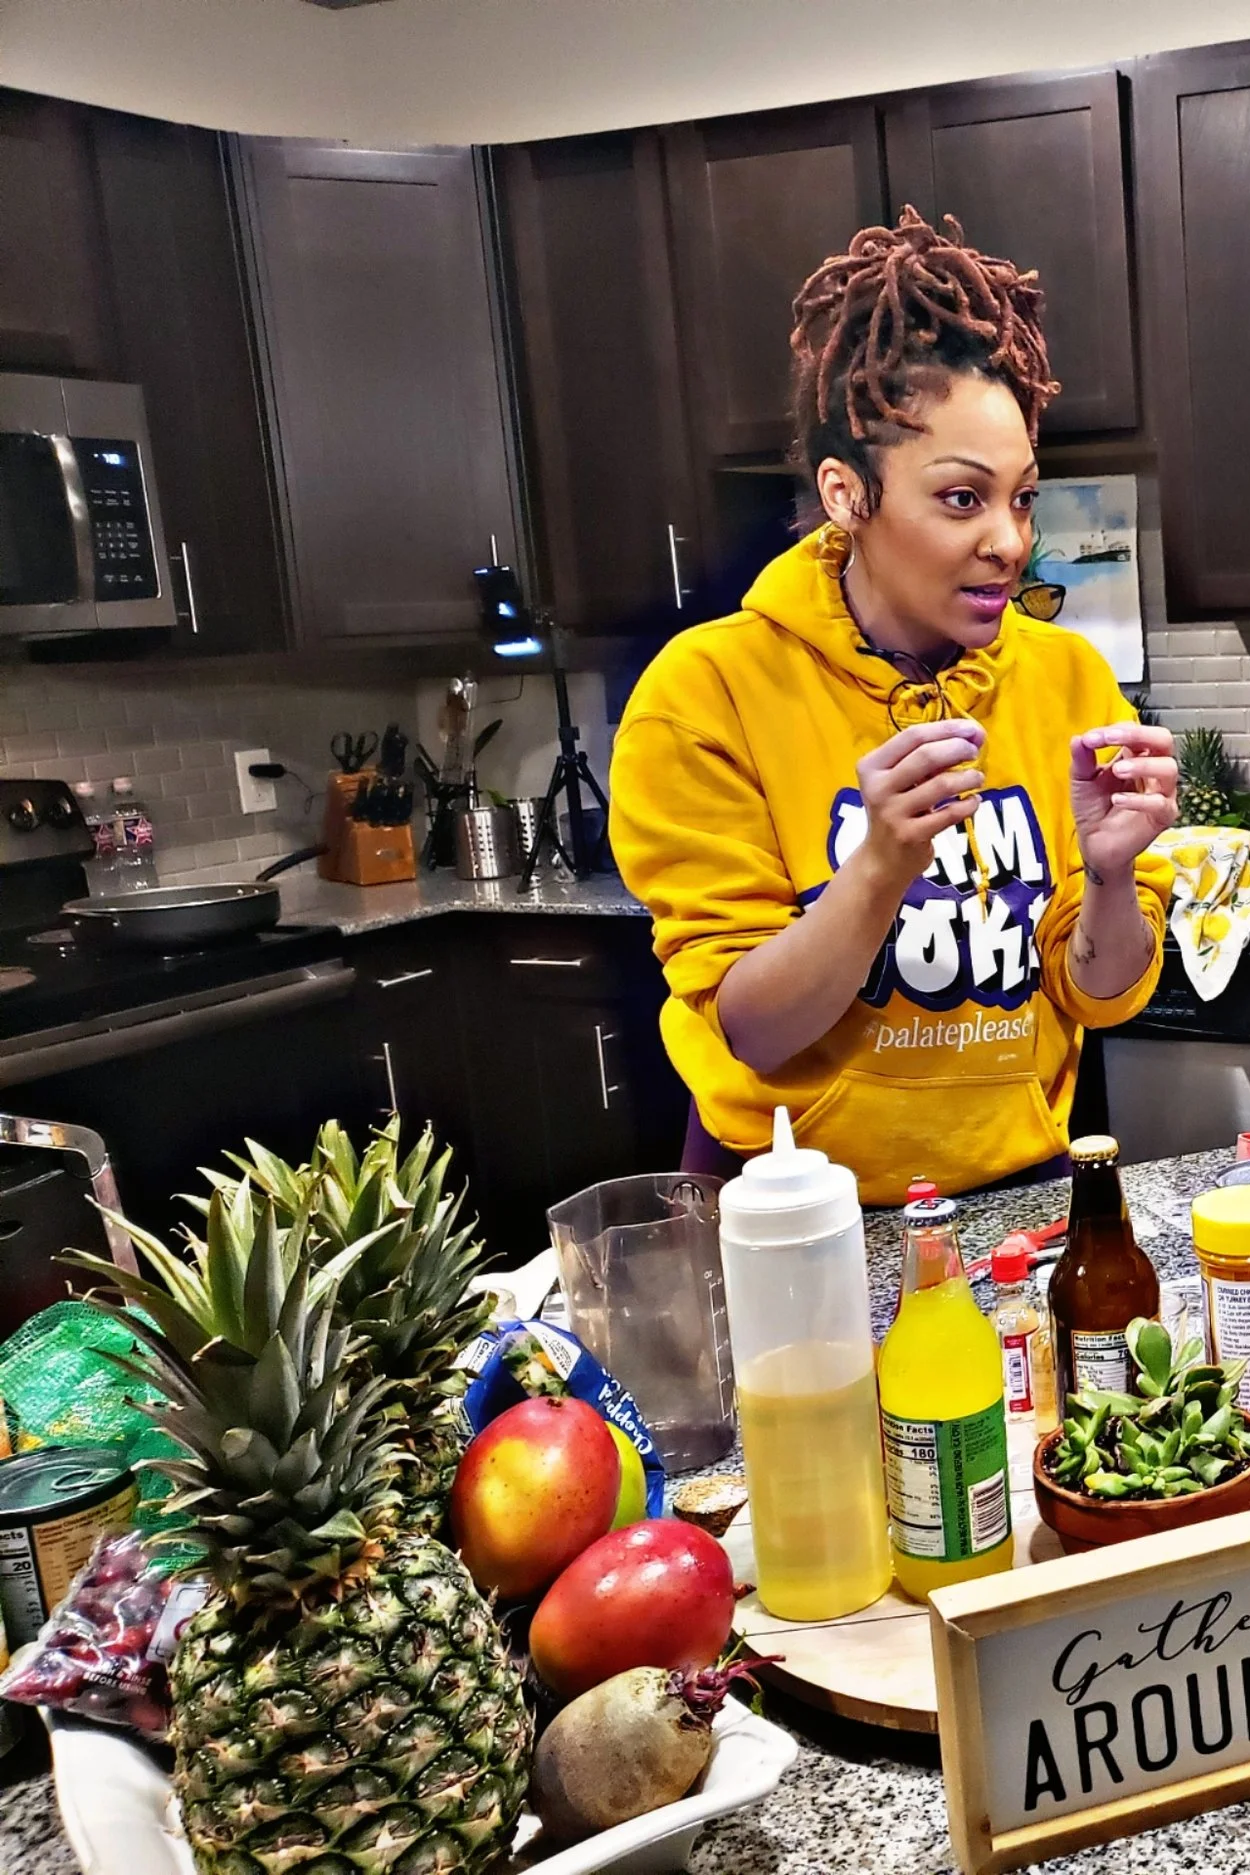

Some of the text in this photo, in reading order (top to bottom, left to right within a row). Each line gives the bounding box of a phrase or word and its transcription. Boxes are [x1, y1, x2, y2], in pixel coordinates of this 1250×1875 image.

[906, 1424, 934, 1434] Facts
[911, 1447, 936, 1459] 180
[12, 1560, 32, 1572] 20
